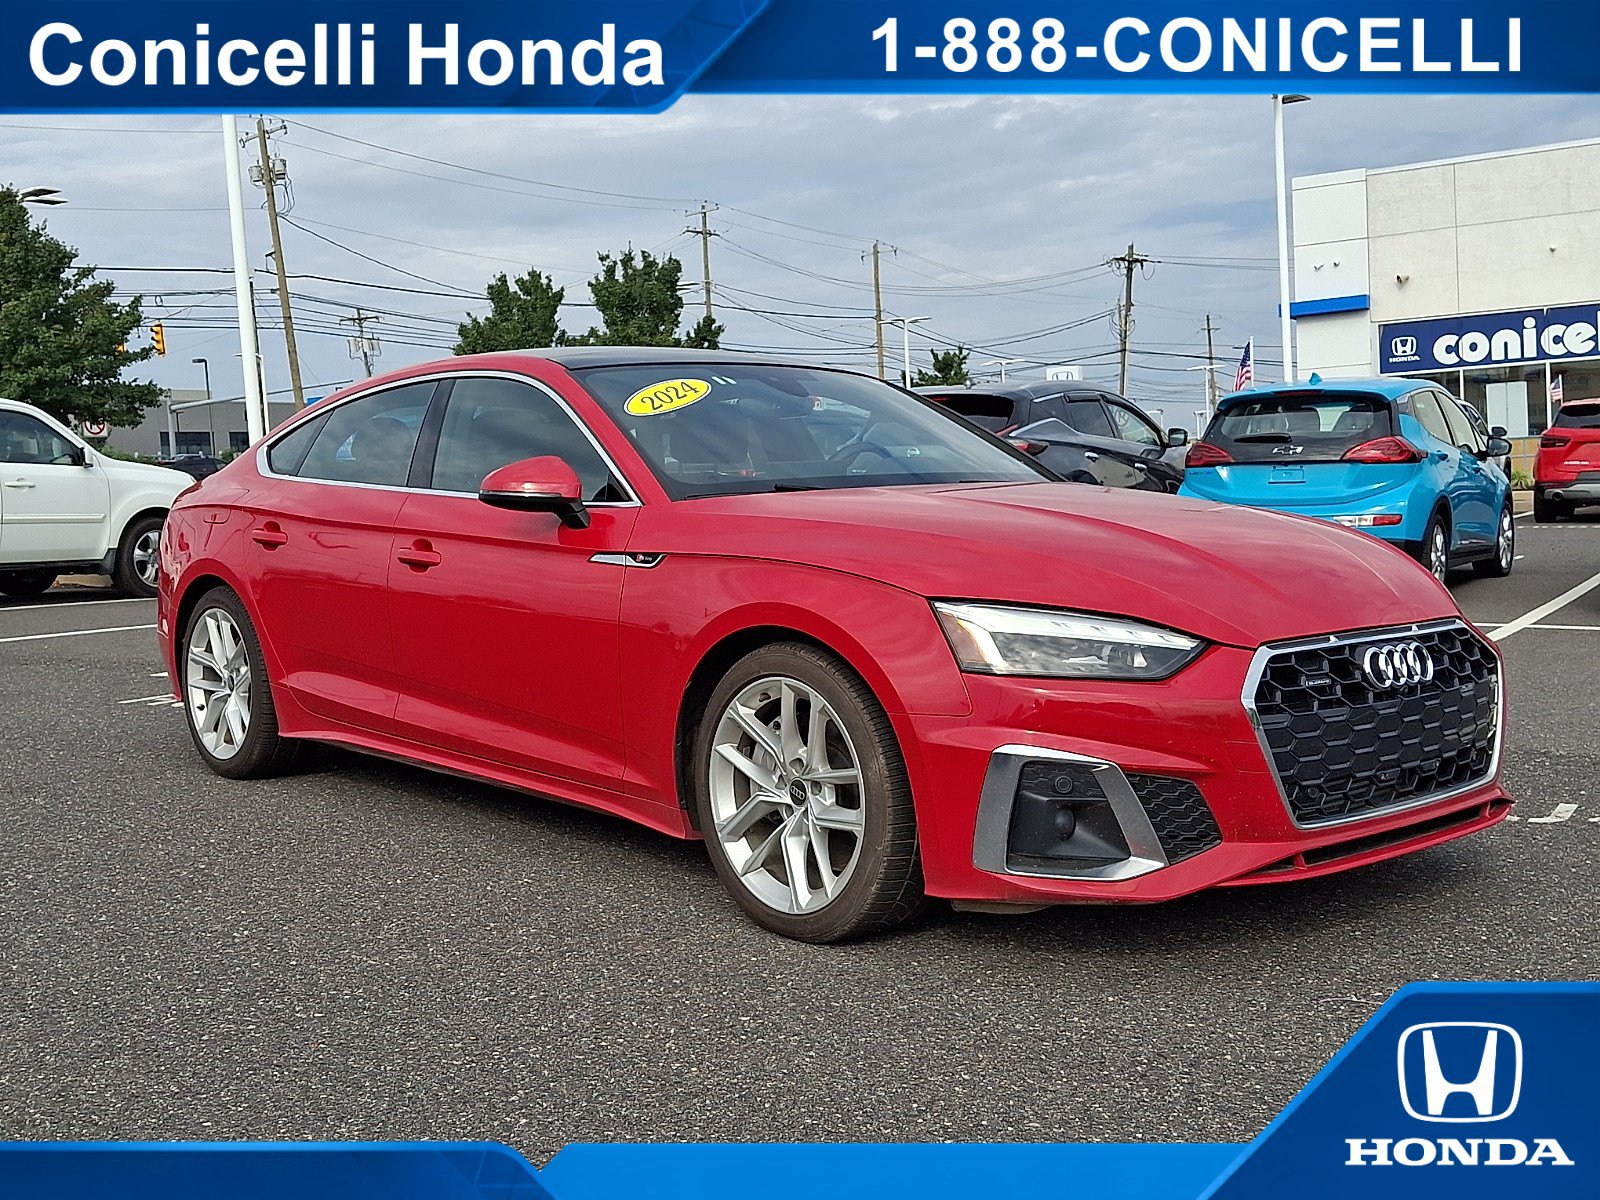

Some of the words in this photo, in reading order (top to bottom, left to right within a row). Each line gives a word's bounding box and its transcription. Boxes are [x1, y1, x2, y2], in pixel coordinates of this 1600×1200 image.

[1432, 311, 1600, 365] conice
[1388, 355, 1421, 363] HONDA
[641, 381, 700, 411] 2024
